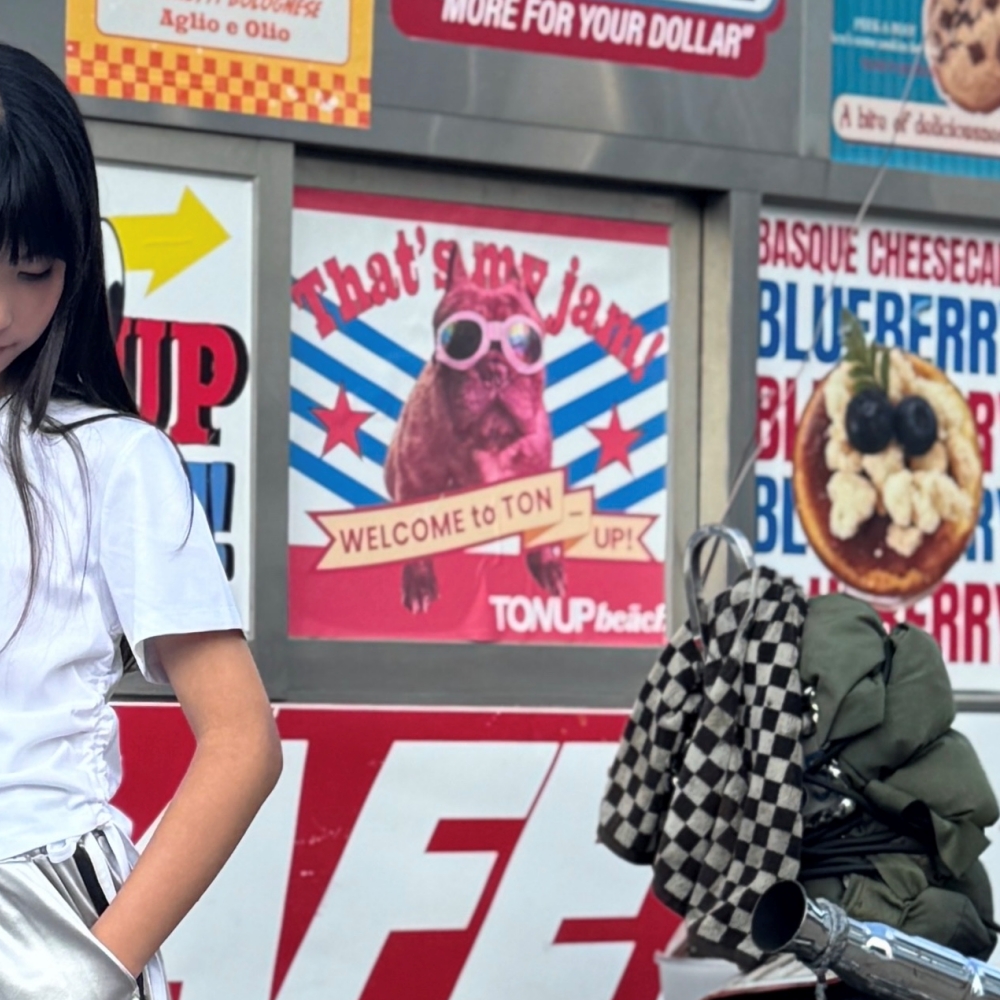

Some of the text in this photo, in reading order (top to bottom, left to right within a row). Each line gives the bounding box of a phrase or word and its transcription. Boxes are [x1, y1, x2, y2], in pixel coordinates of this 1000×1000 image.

[159, 7, 291, 43] Aglio e Olio
[441, 0, 517, 31] MORE
[521, 1, 576, 38] FOR
[578, 11, 648, 46] YOUR
[839, 103, 851, 129] A
[759, 218, 1000, 288] BASQUE CHEESECA
[290, 225, 459, 339] That's
[544, 255, 665, 383] jam!
[758, 278, 998, 376] BLUEBERR
[340, 511, 465, 554] WELCOME
[471, 503, 496, 529] to
[501, 486, 553, 520] TON
[593, 526, 634, 551] UP!
